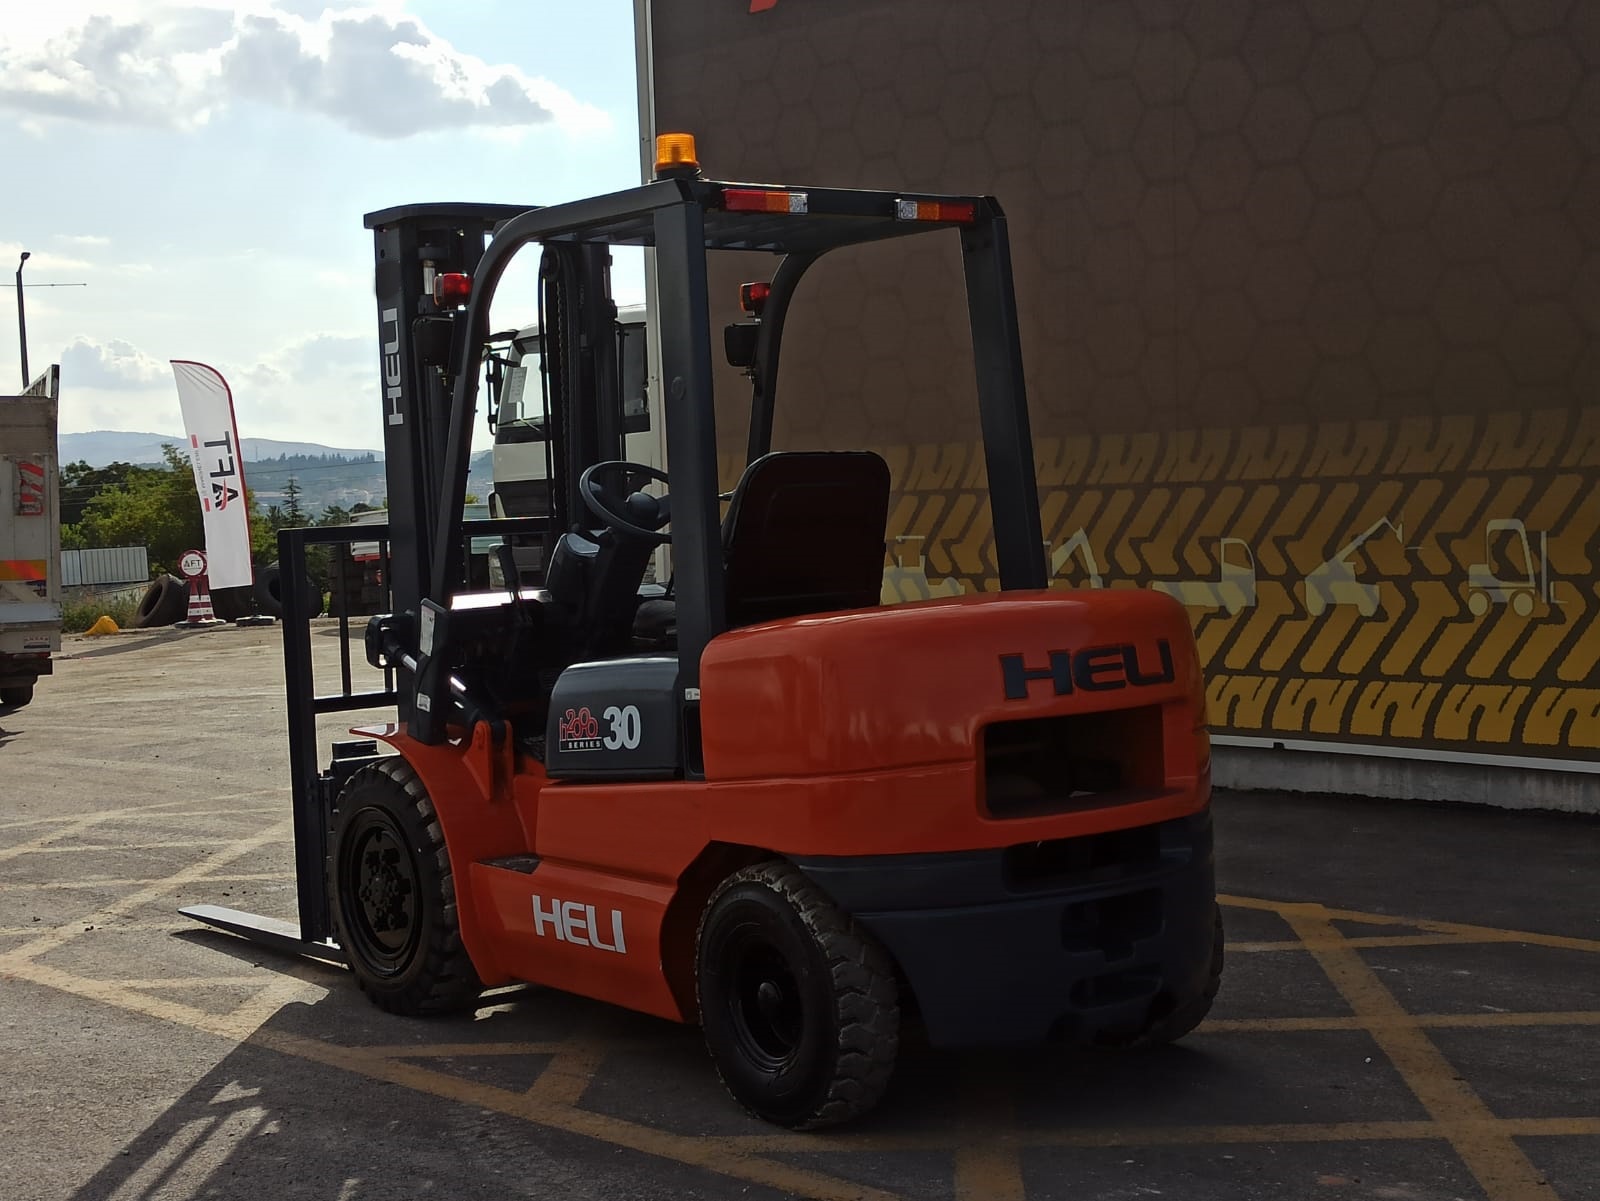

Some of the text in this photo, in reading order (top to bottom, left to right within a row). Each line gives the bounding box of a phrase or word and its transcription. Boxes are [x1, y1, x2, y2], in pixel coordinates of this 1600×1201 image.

[382, 307, 403, 426] HELI
[184, 559, 202, 568] AFT
[1000, 639, 1175, 700] HELI
[568, 740, 601, 749] SERIES
[602, 704, 641, 751] 30
[532, 894, 627, 954] HELI
